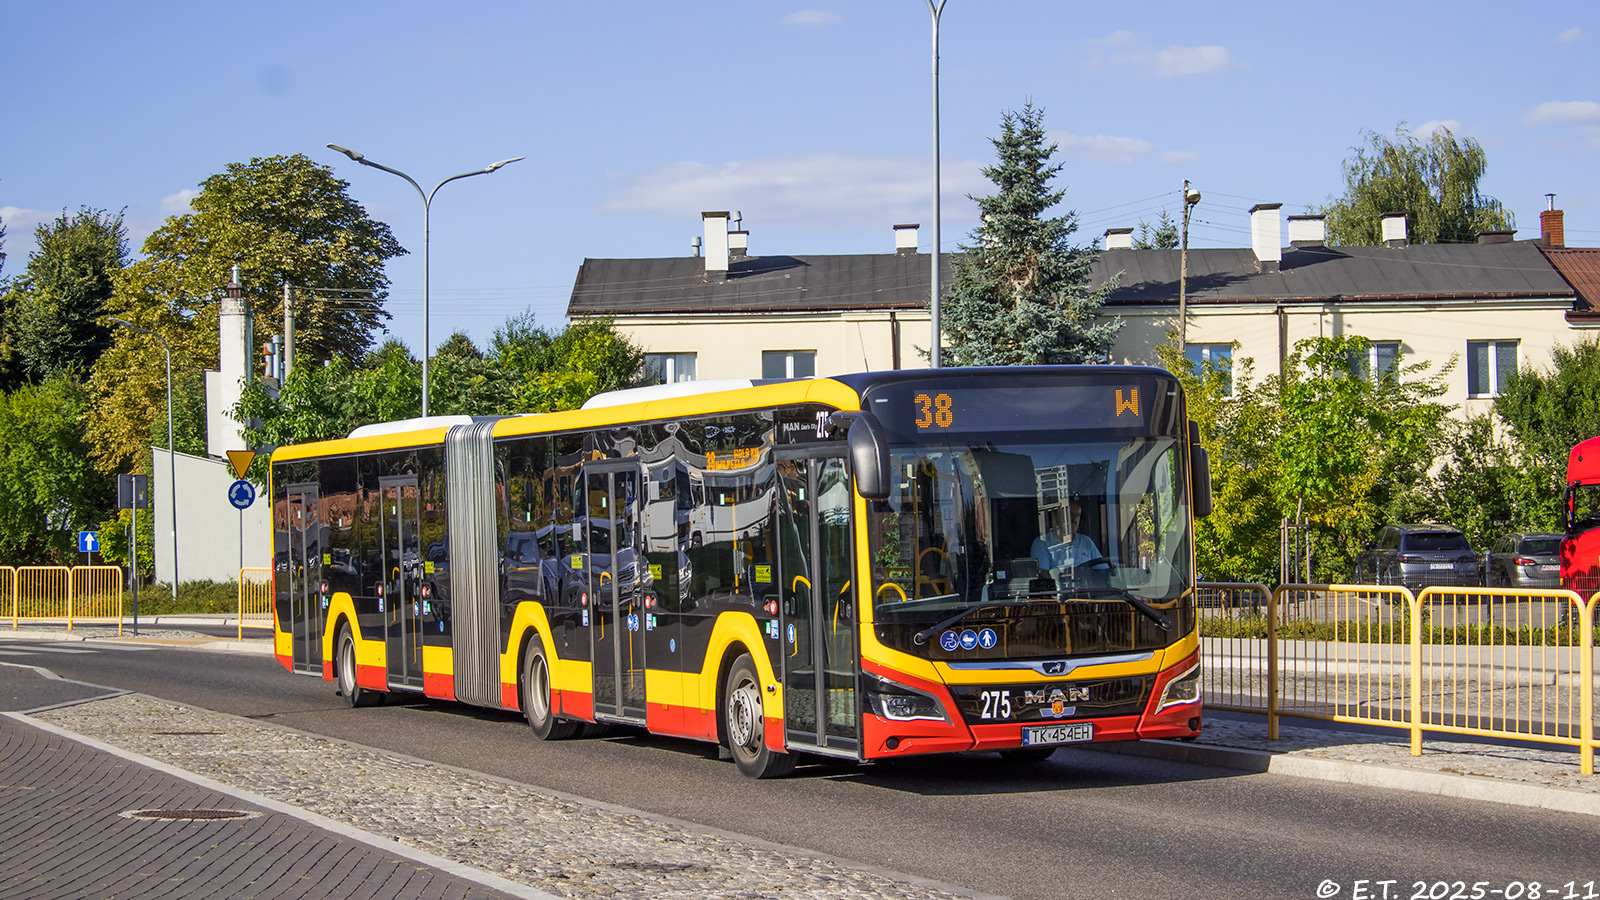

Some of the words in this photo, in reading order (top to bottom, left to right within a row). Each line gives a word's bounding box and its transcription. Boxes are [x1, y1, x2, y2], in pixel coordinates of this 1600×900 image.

[914, 393, 953, 428] 38
[1115, 389, 1139, 417] W
[783, 421, 800, 432] MAN
[981, 690, 1011, 719] 275
[1024, 687, 1090, 704] MAN
[1032, 729, 1047, 743] TK
[1052, 726, 1090, 741] 454EH
